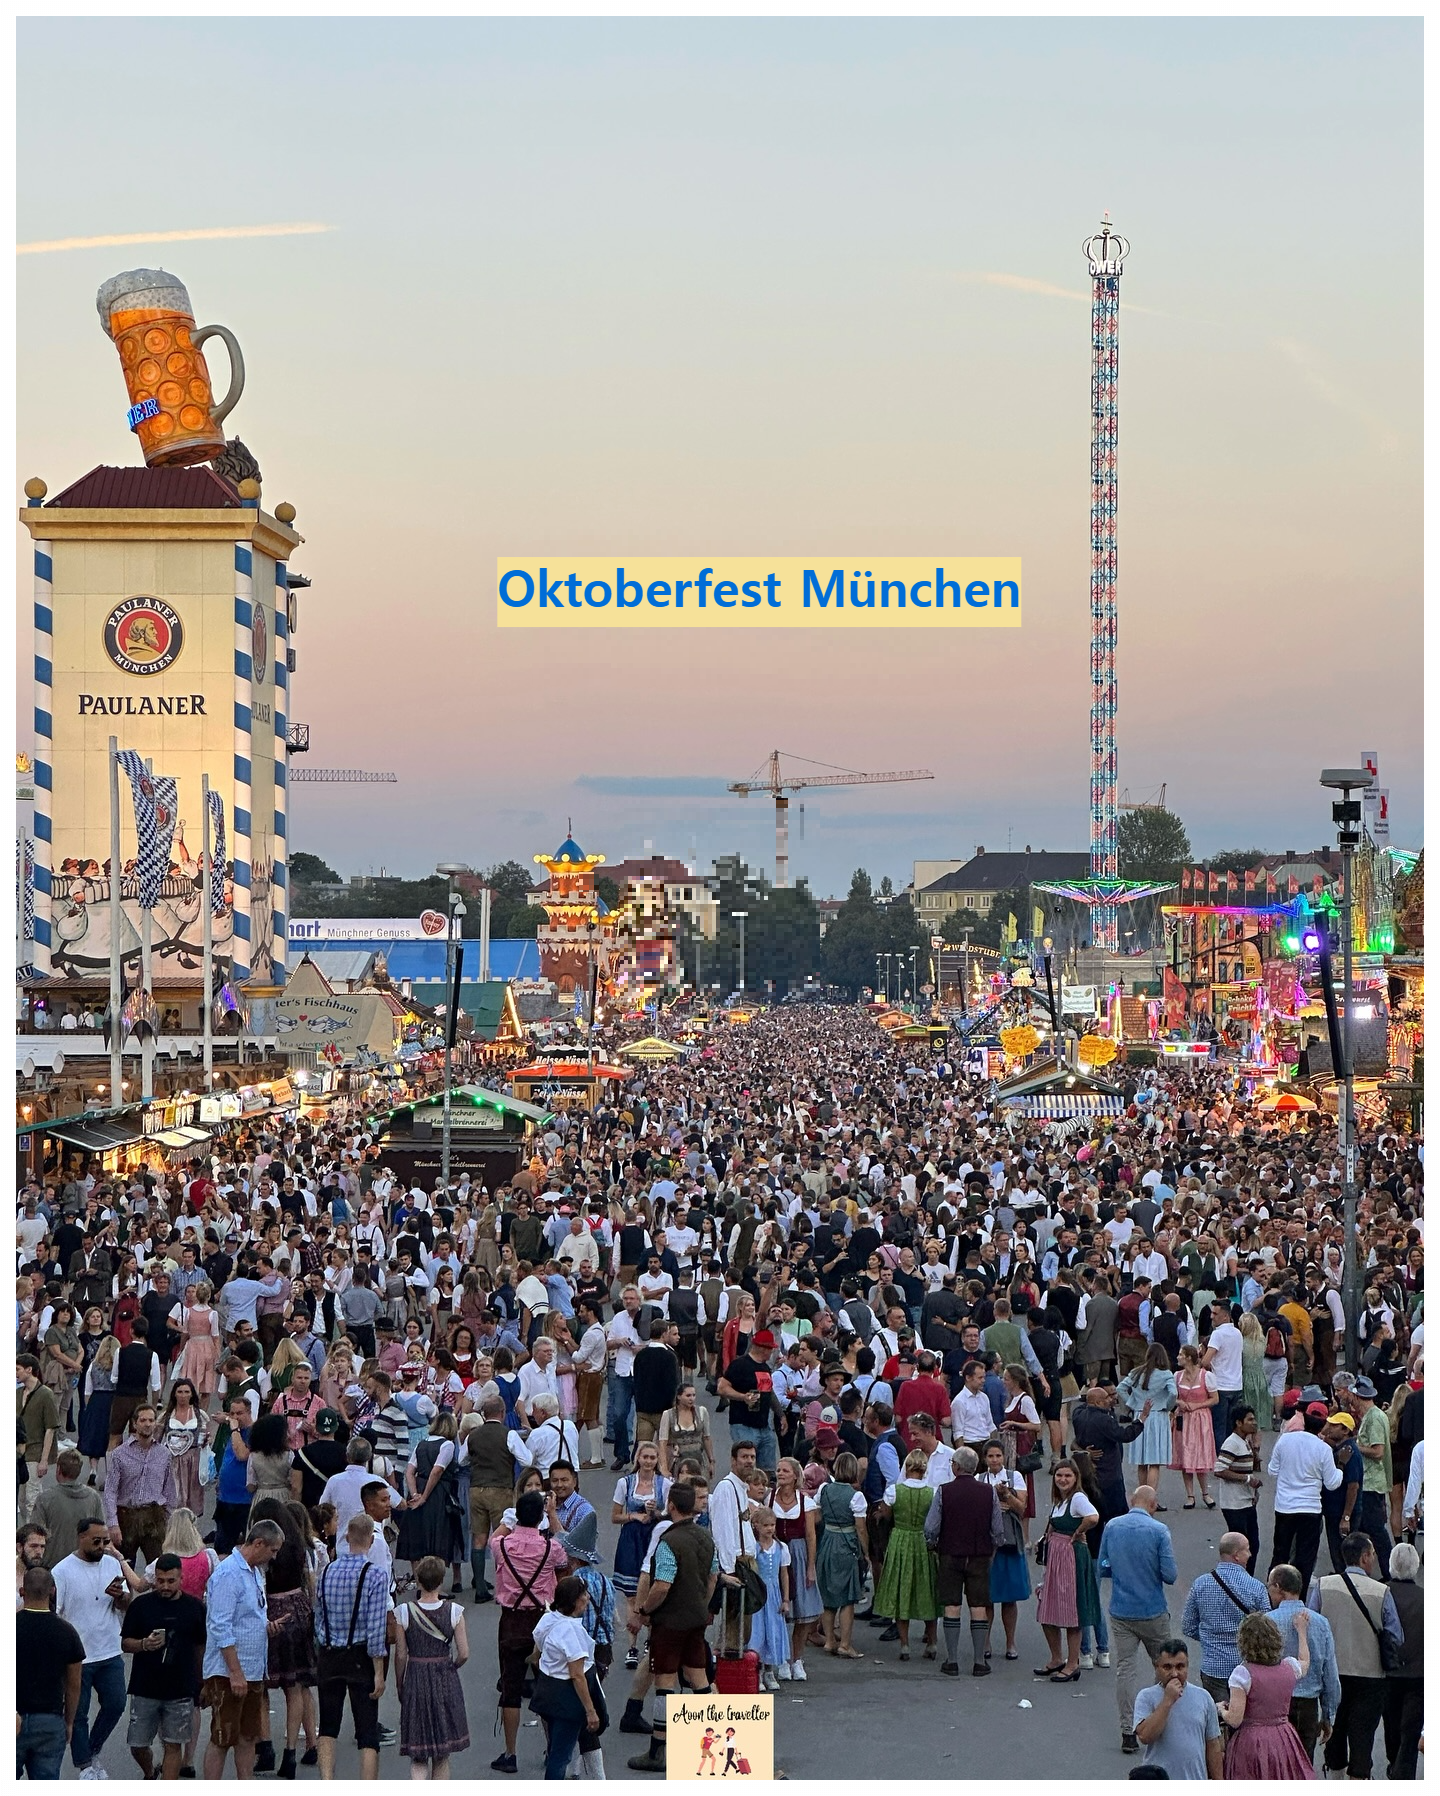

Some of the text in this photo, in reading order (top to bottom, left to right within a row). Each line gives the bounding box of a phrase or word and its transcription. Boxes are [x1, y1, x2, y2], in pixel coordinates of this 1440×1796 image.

[108, 599, 179, 627] PAULANER
[114, 653, 173, 673] MÜNCHEN
[78, 694, 207, 715] PAULANER
[327, 928, 411, 937] Münchner Genuss
[304, 997, 359, 1014] Fischhaus
